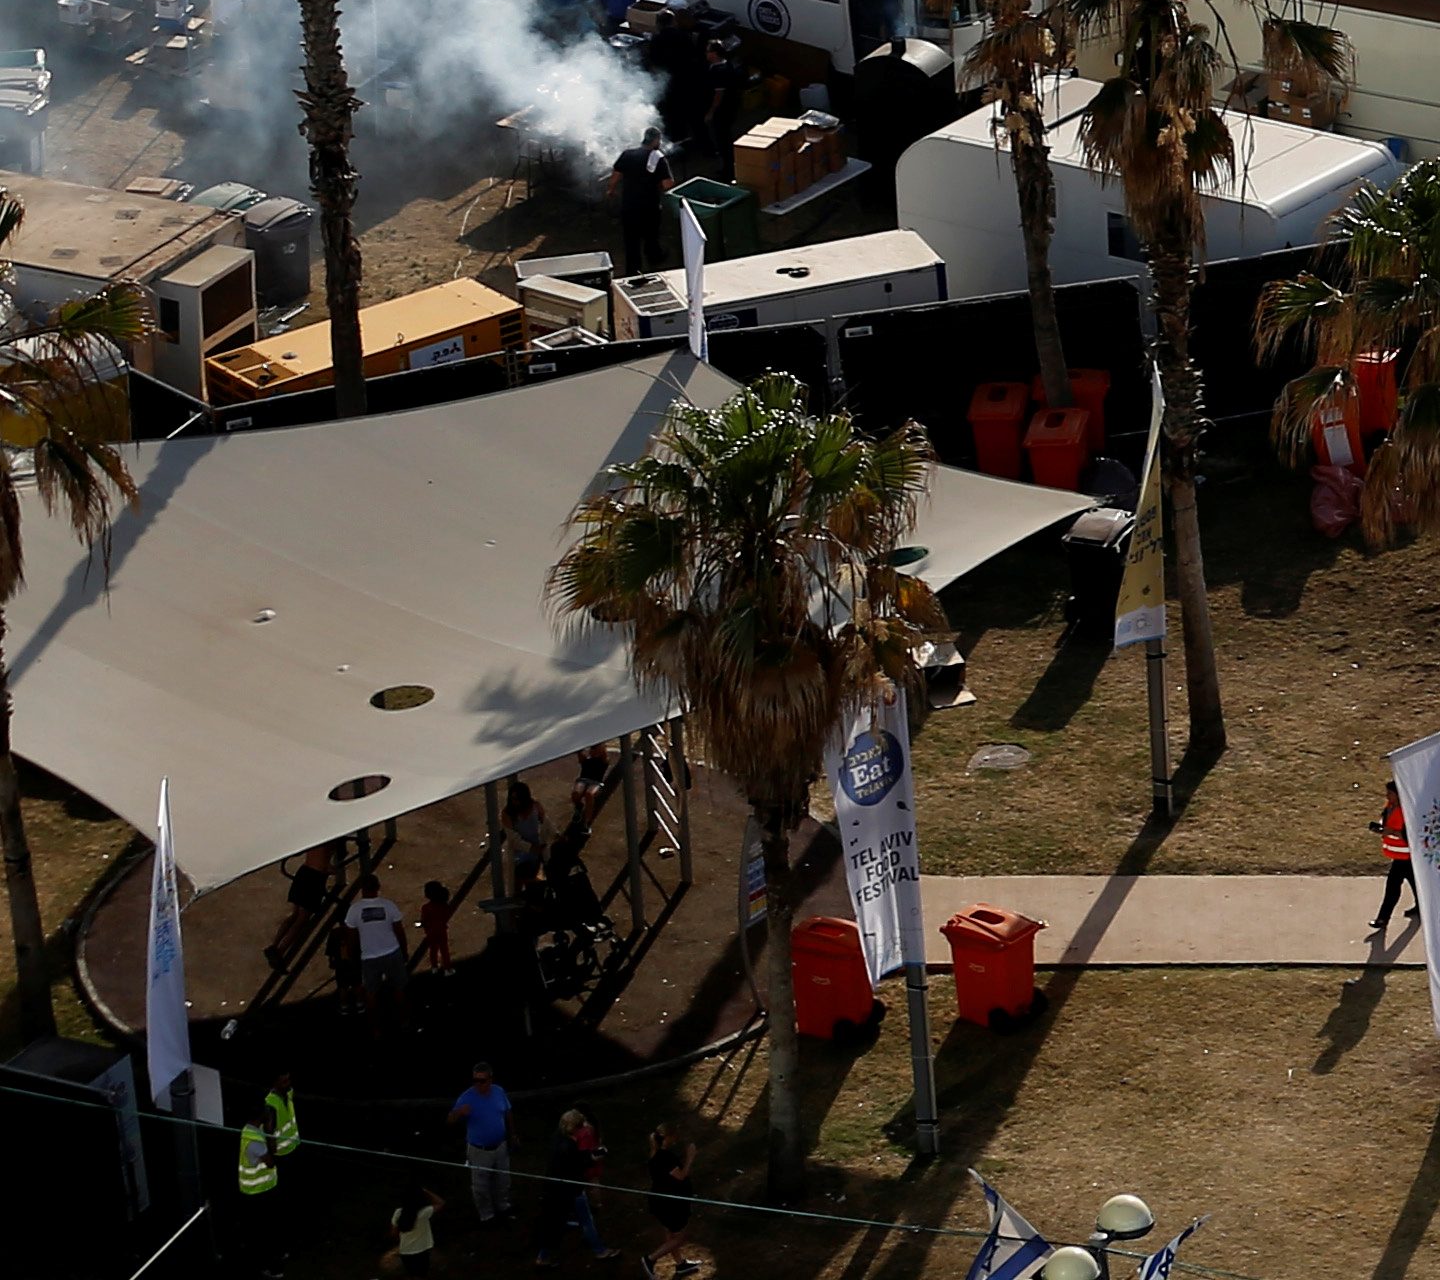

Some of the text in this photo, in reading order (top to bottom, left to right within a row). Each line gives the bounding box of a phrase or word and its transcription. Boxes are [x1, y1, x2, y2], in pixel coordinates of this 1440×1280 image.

[850, 756, 892, 789] Eat
[850, 831, 914, 869] TEL AVIV
[866, 850, 901, 883] FOOD
[856, 866, 919, 907] FESTIVAL
